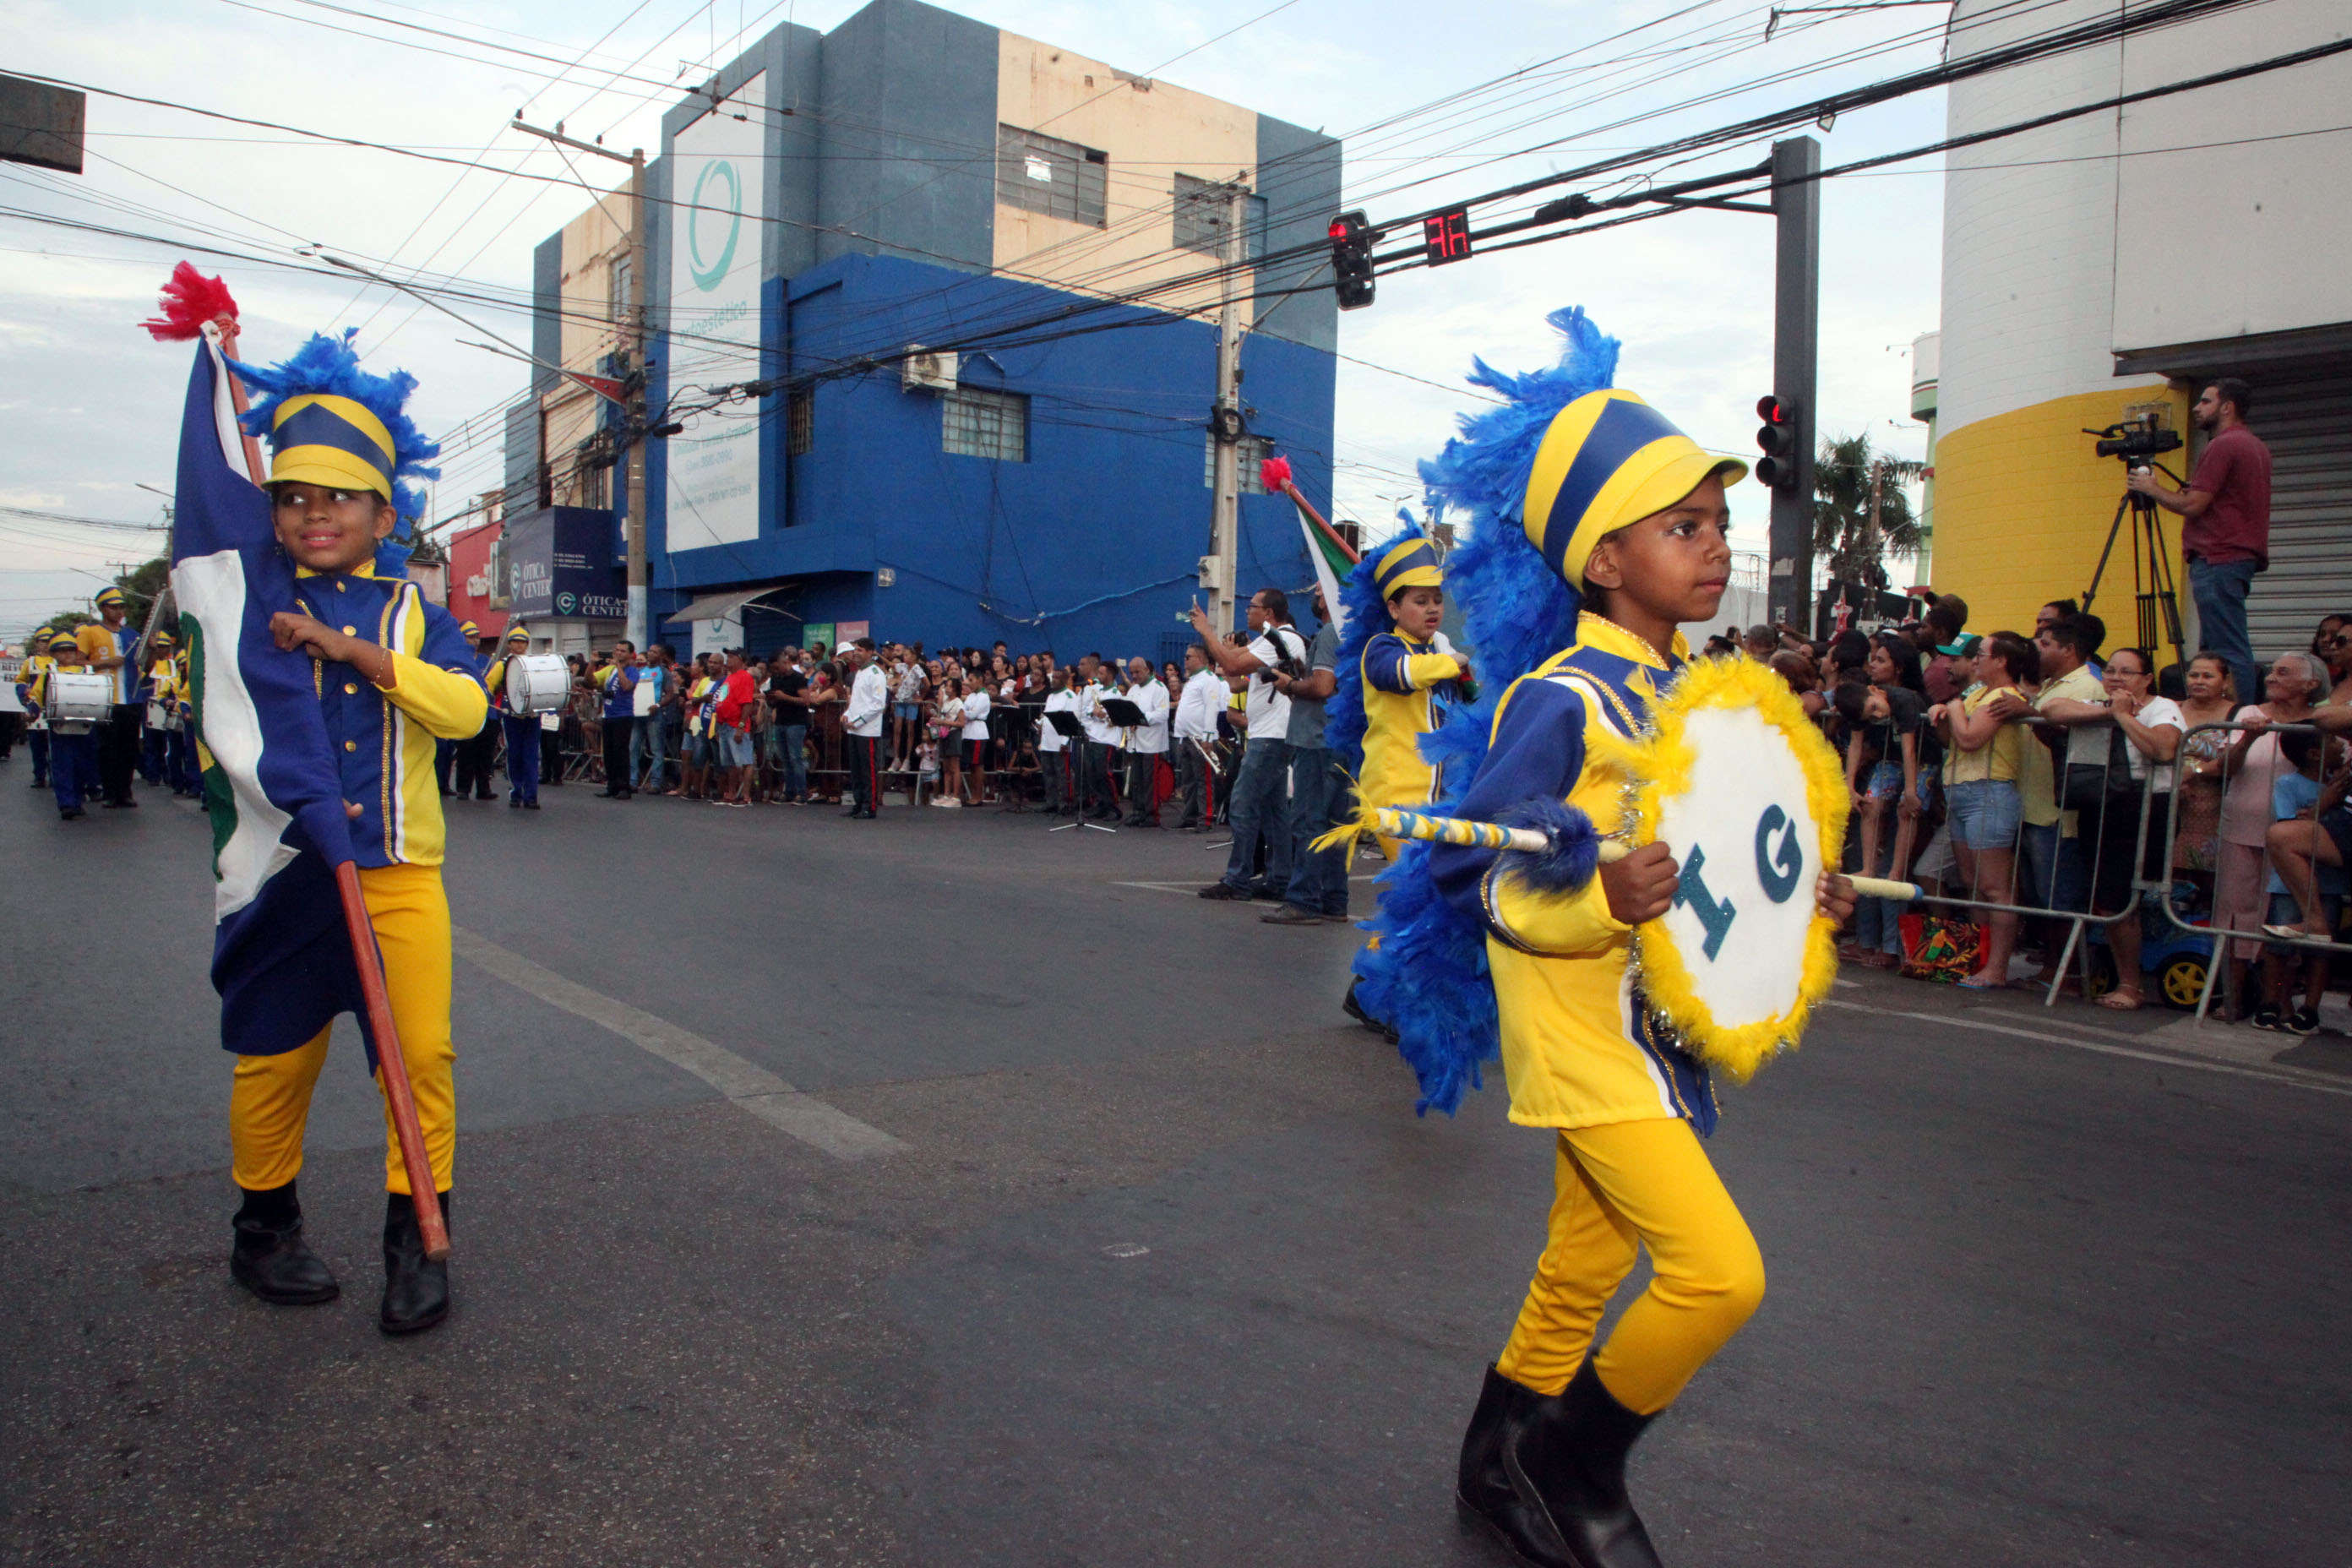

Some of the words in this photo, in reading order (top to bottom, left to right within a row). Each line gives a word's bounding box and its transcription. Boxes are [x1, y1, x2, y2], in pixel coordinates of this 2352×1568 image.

[523, 559, 546, 581] ÓTICA
[523, 579, 552, 599] CENTER
[582, 592, 622, 607] ÓTICA
